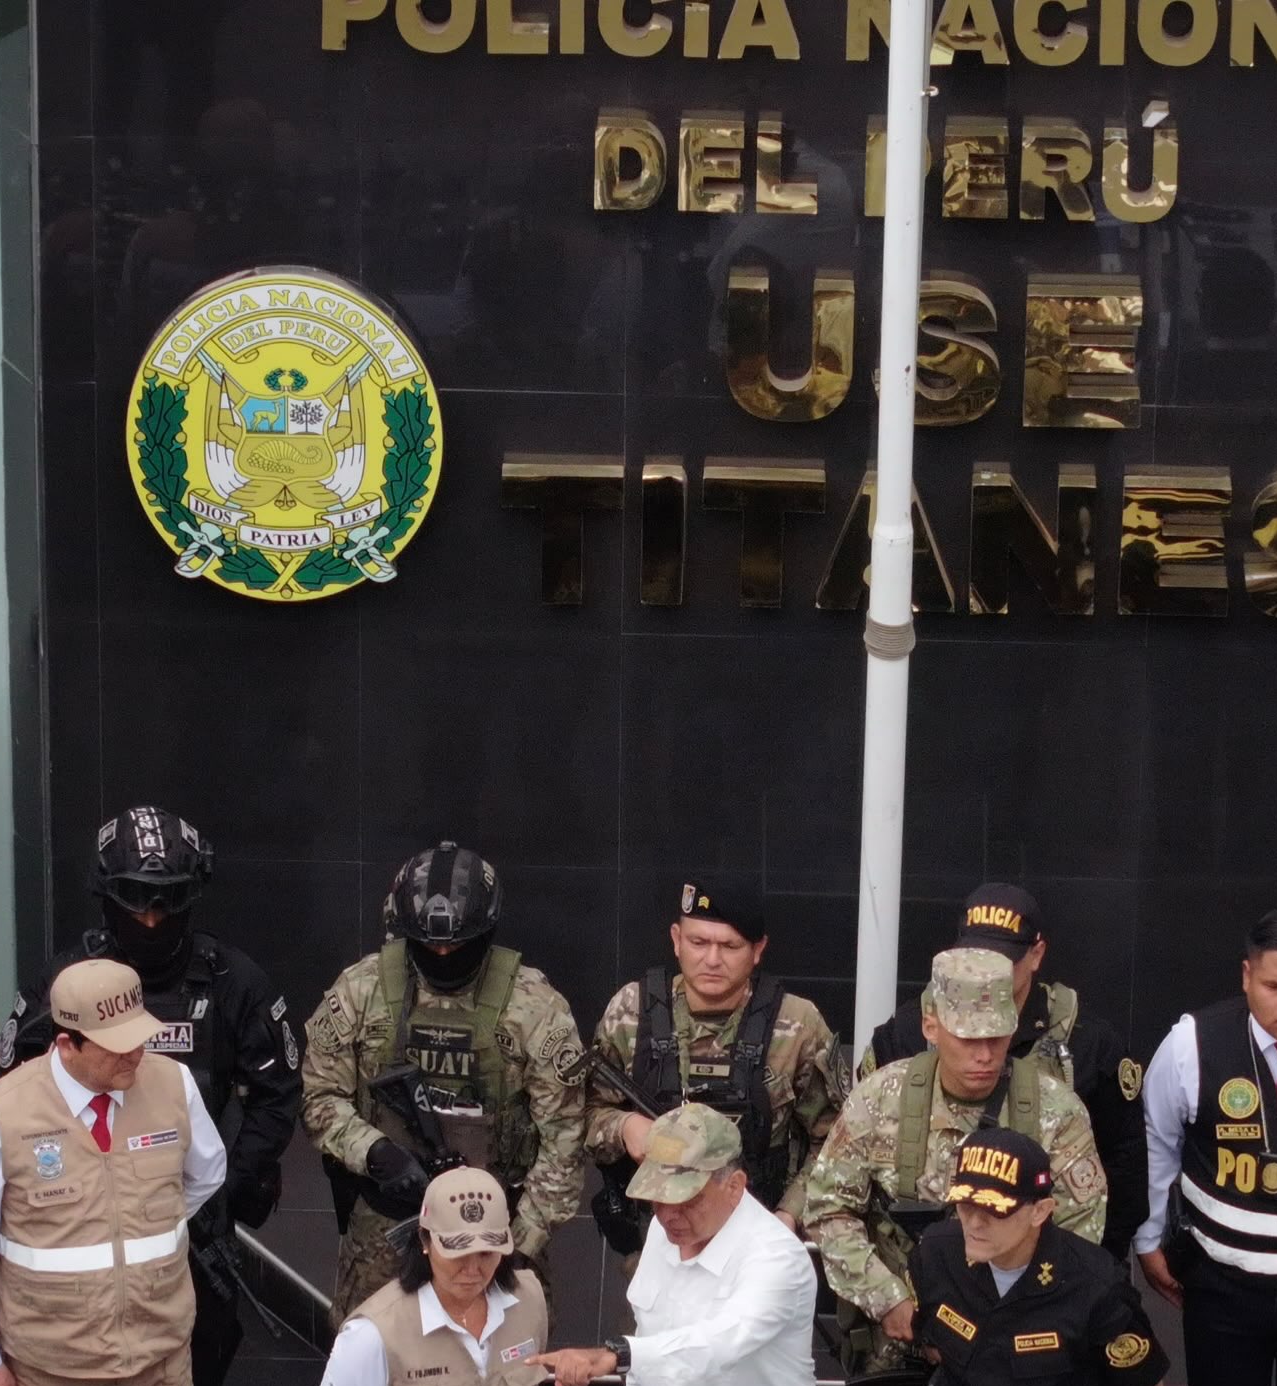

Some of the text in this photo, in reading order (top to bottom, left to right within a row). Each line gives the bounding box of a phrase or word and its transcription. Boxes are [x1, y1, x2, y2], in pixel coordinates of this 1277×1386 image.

[593, 108, 820, 215] DEL
[161, 288, 409, 374] POLICIA NACIONAL
[225, 319, 346, 351] DEL PERU
[725, 266, 1144, 430] USE
[193, 499, 375, 547] DIOS PATRIA LEY
[966, 905, 1021, 934] POLICIA
[58, 1009, 80, 1023] PERU
[404, 1048, 476, 1077] SUAT
[958, 1146, 1019, 1186] POLICIA
